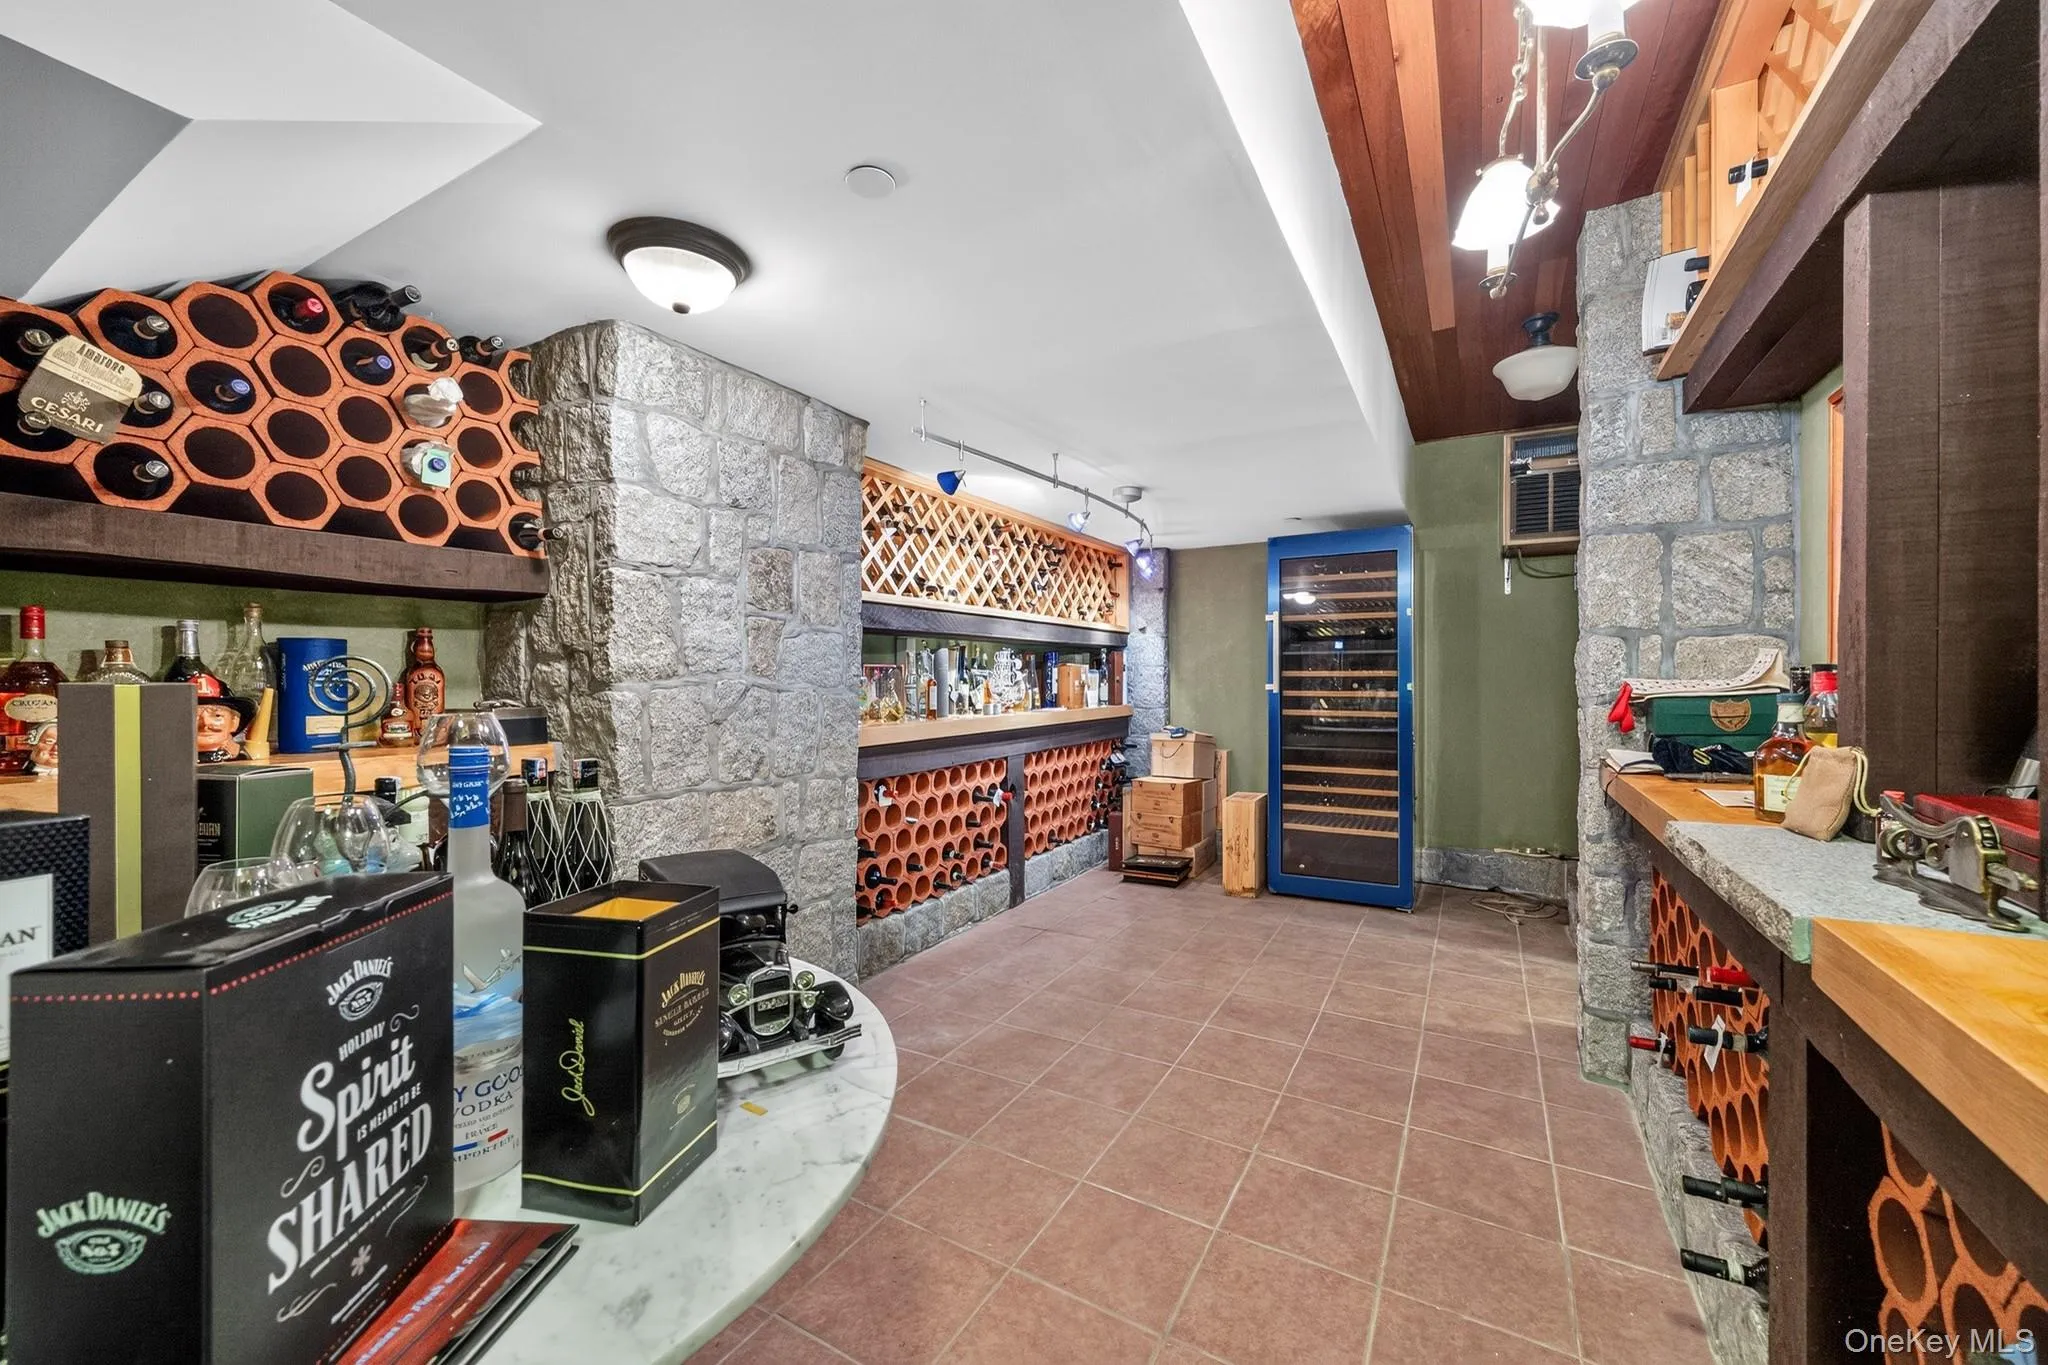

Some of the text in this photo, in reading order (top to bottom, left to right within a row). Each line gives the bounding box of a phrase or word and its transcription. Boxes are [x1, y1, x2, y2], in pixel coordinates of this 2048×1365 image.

[76, 343, 125, 375] Amarone
[30, 396, 104, 433] CESARI
[325, 968, 356, 1006] JACK
[338, 1021, 386, 1062] HOLIDAY
[296, 1034, 416, 1162] Spirit
[475, 1066, 524, 1097] GOO
[357, 1082, 421, 1142] IS MEANT TO BE
[36, 1191, 173, 1238] JACK DANIEL'S
[267, 1102, 432, 1296] SHARED
